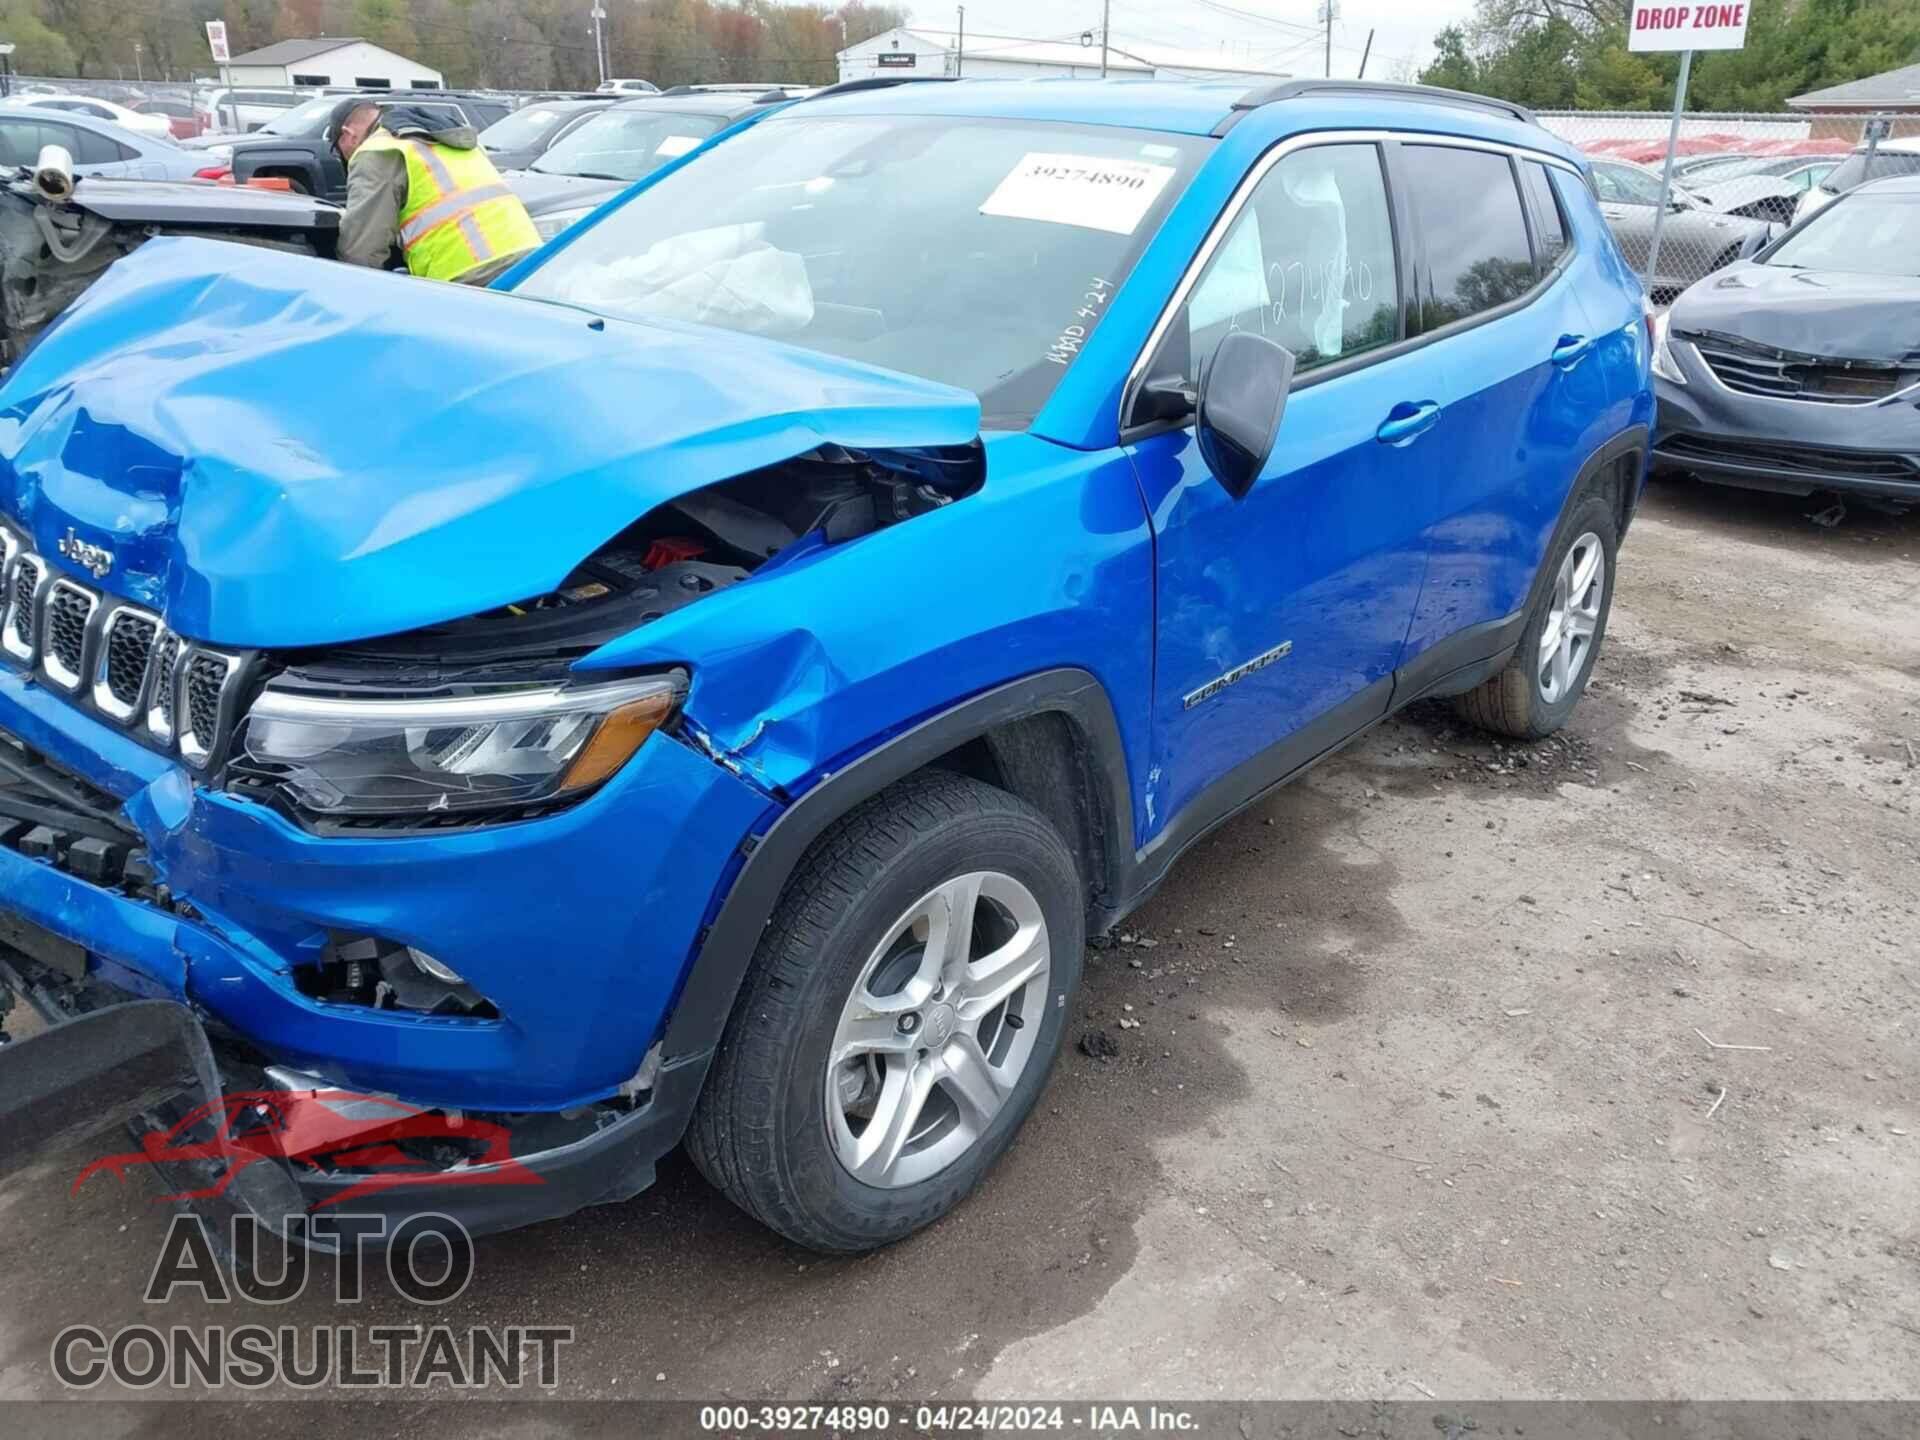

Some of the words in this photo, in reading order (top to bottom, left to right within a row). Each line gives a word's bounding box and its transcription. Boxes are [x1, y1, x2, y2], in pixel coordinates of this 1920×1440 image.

[1636, 7, 1690, 30] DROP
[1693, 4, 1744, 28] ZONE
[1026, 164, 1145, 191] 39274890
[58, 526, 113, 579] Jeep
[1183, 640, 1293, 711] COMPASS
